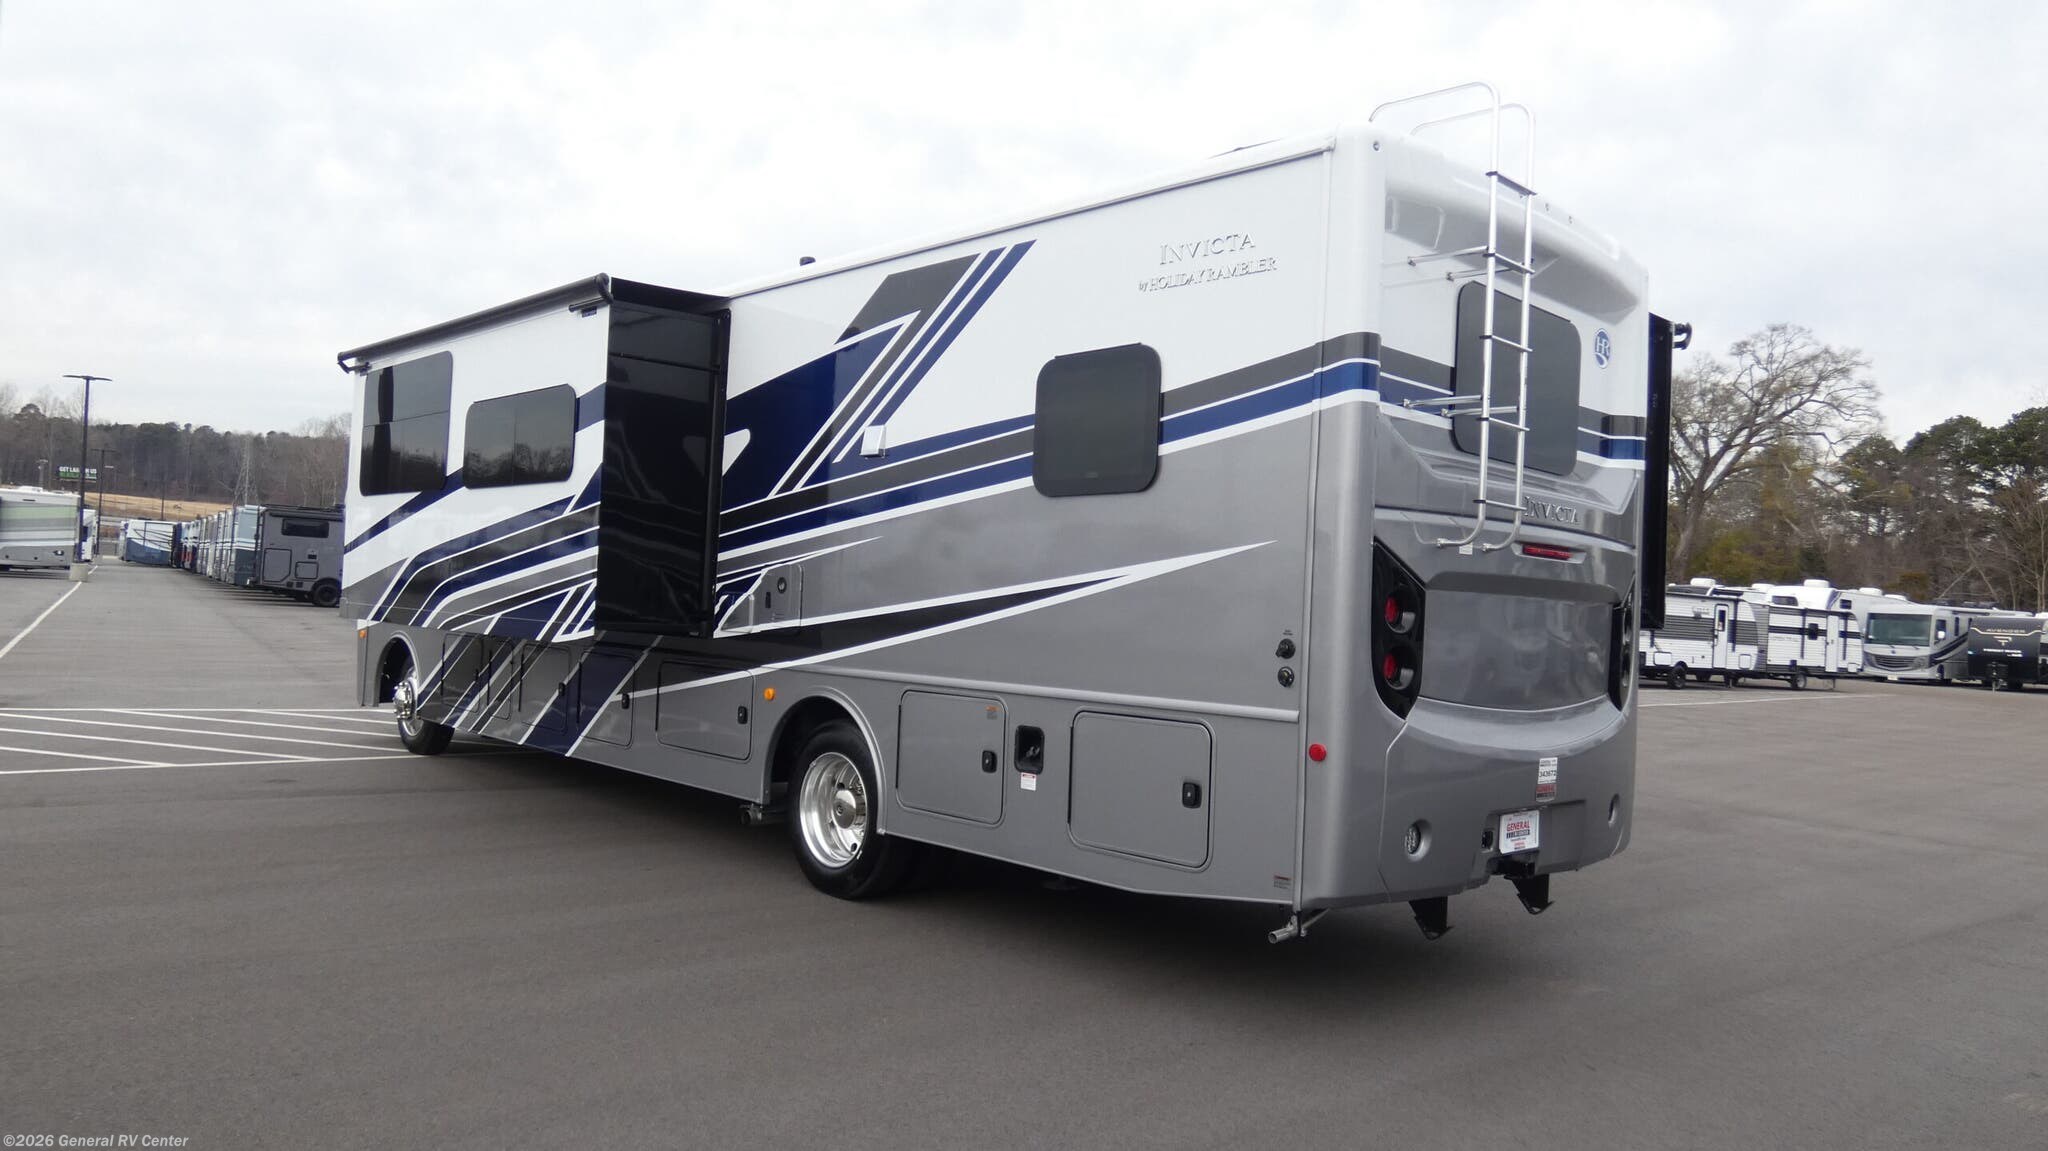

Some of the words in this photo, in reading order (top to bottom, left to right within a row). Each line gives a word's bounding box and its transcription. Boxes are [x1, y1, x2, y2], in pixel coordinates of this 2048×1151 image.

[1160, 233, 1256, 265] INVICTA
[1524, 496, 1579, 525] INVICTA
[1507, 820, 1530, 832] GENERAL
